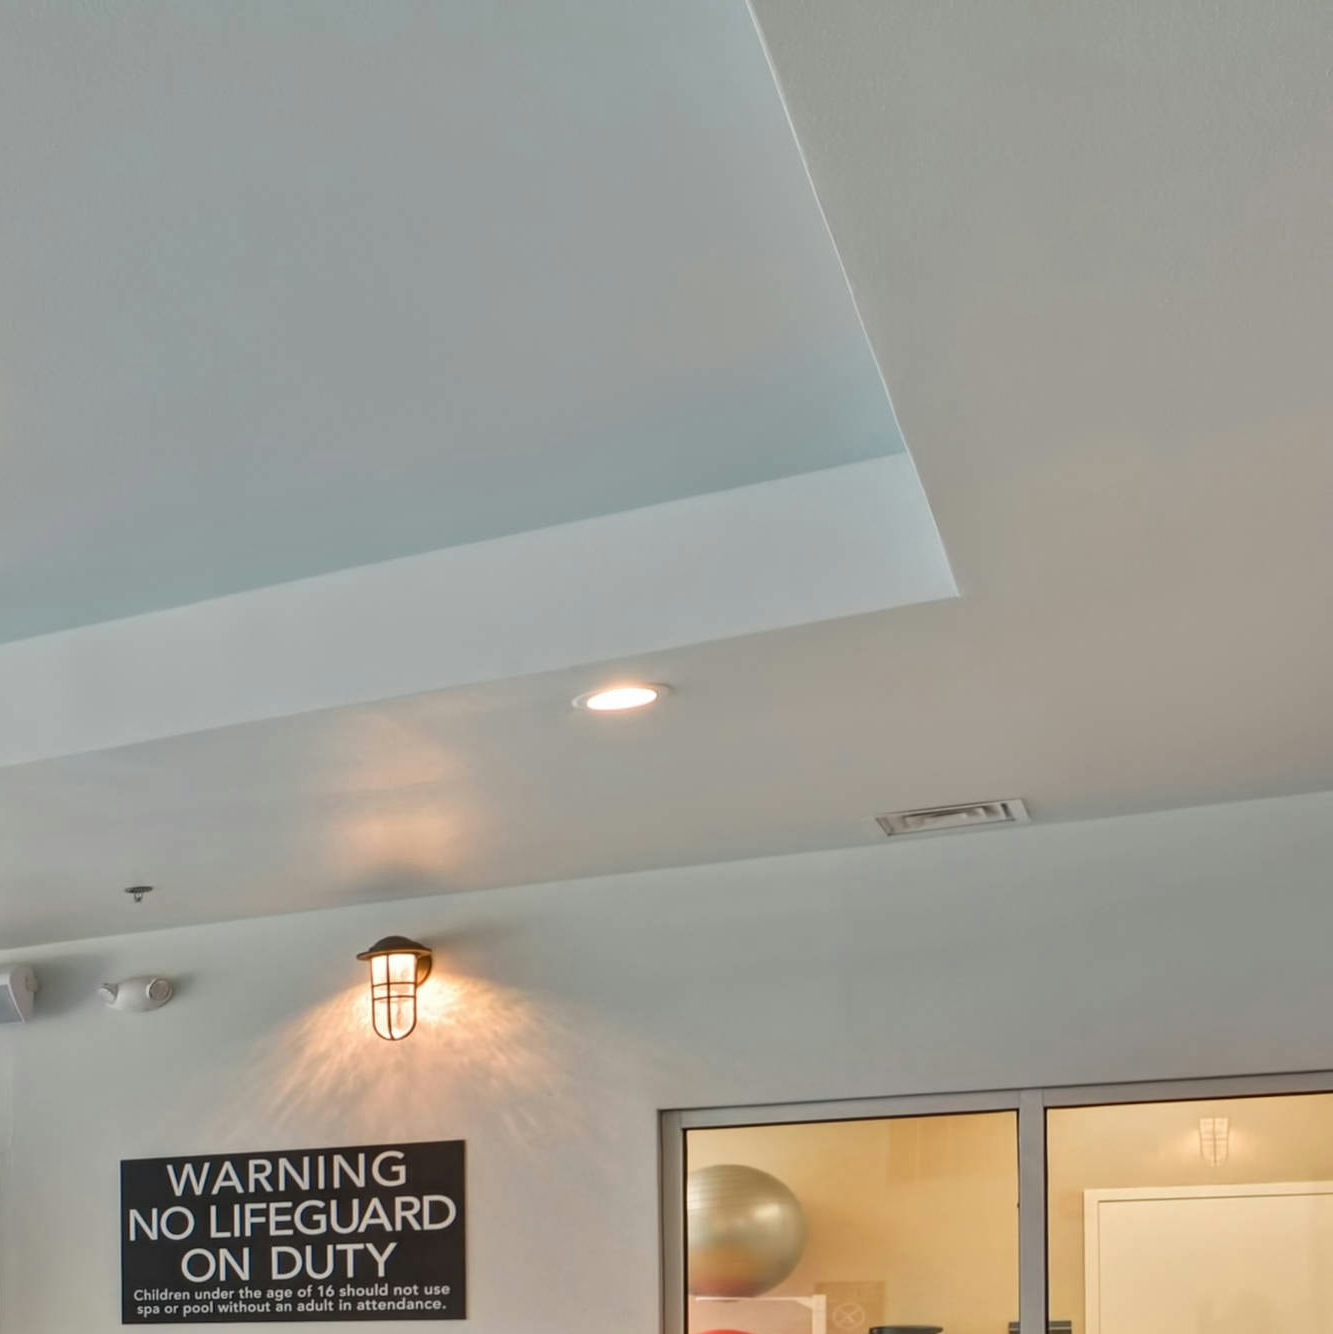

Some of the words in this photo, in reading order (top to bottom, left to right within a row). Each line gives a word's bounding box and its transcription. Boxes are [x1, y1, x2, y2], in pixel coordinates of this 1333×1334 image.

[166, 1150, 407, 1197] WARNING
[128, 1206, 196, 1242] NO
[209, 1194, 457, 1239] LIFEGUARD
[180, 1246, 250, 1283] ON
[271, 1242, 397, 1281] DUTY
[133, 1288, 190, 1302] Children
[194, 1286, 235, 1300] under
[239, 1286, 262, 1299] the
[266, 1289, 293, 1301] age
[297, 1285, 313, 1298] of
[317, 1285, 335, 1298] 16
[339, 1283, 389, 1297] should
[393, 1284, 419, 1296] not
[424, 1285, 451, 1295] use
[137, 1304, 160, 1318] spa
[164, 1304, 179, 1314] or
[183, 1301, 214, 1317] pool
[218, 1301, 271, 1313] without
[275, 1303, 293, 1313] an
[297, 1299, 334, 1312] adult
[339, 1298, 352, 1311] in
[356, 1297, 447, 1311] attendance.
